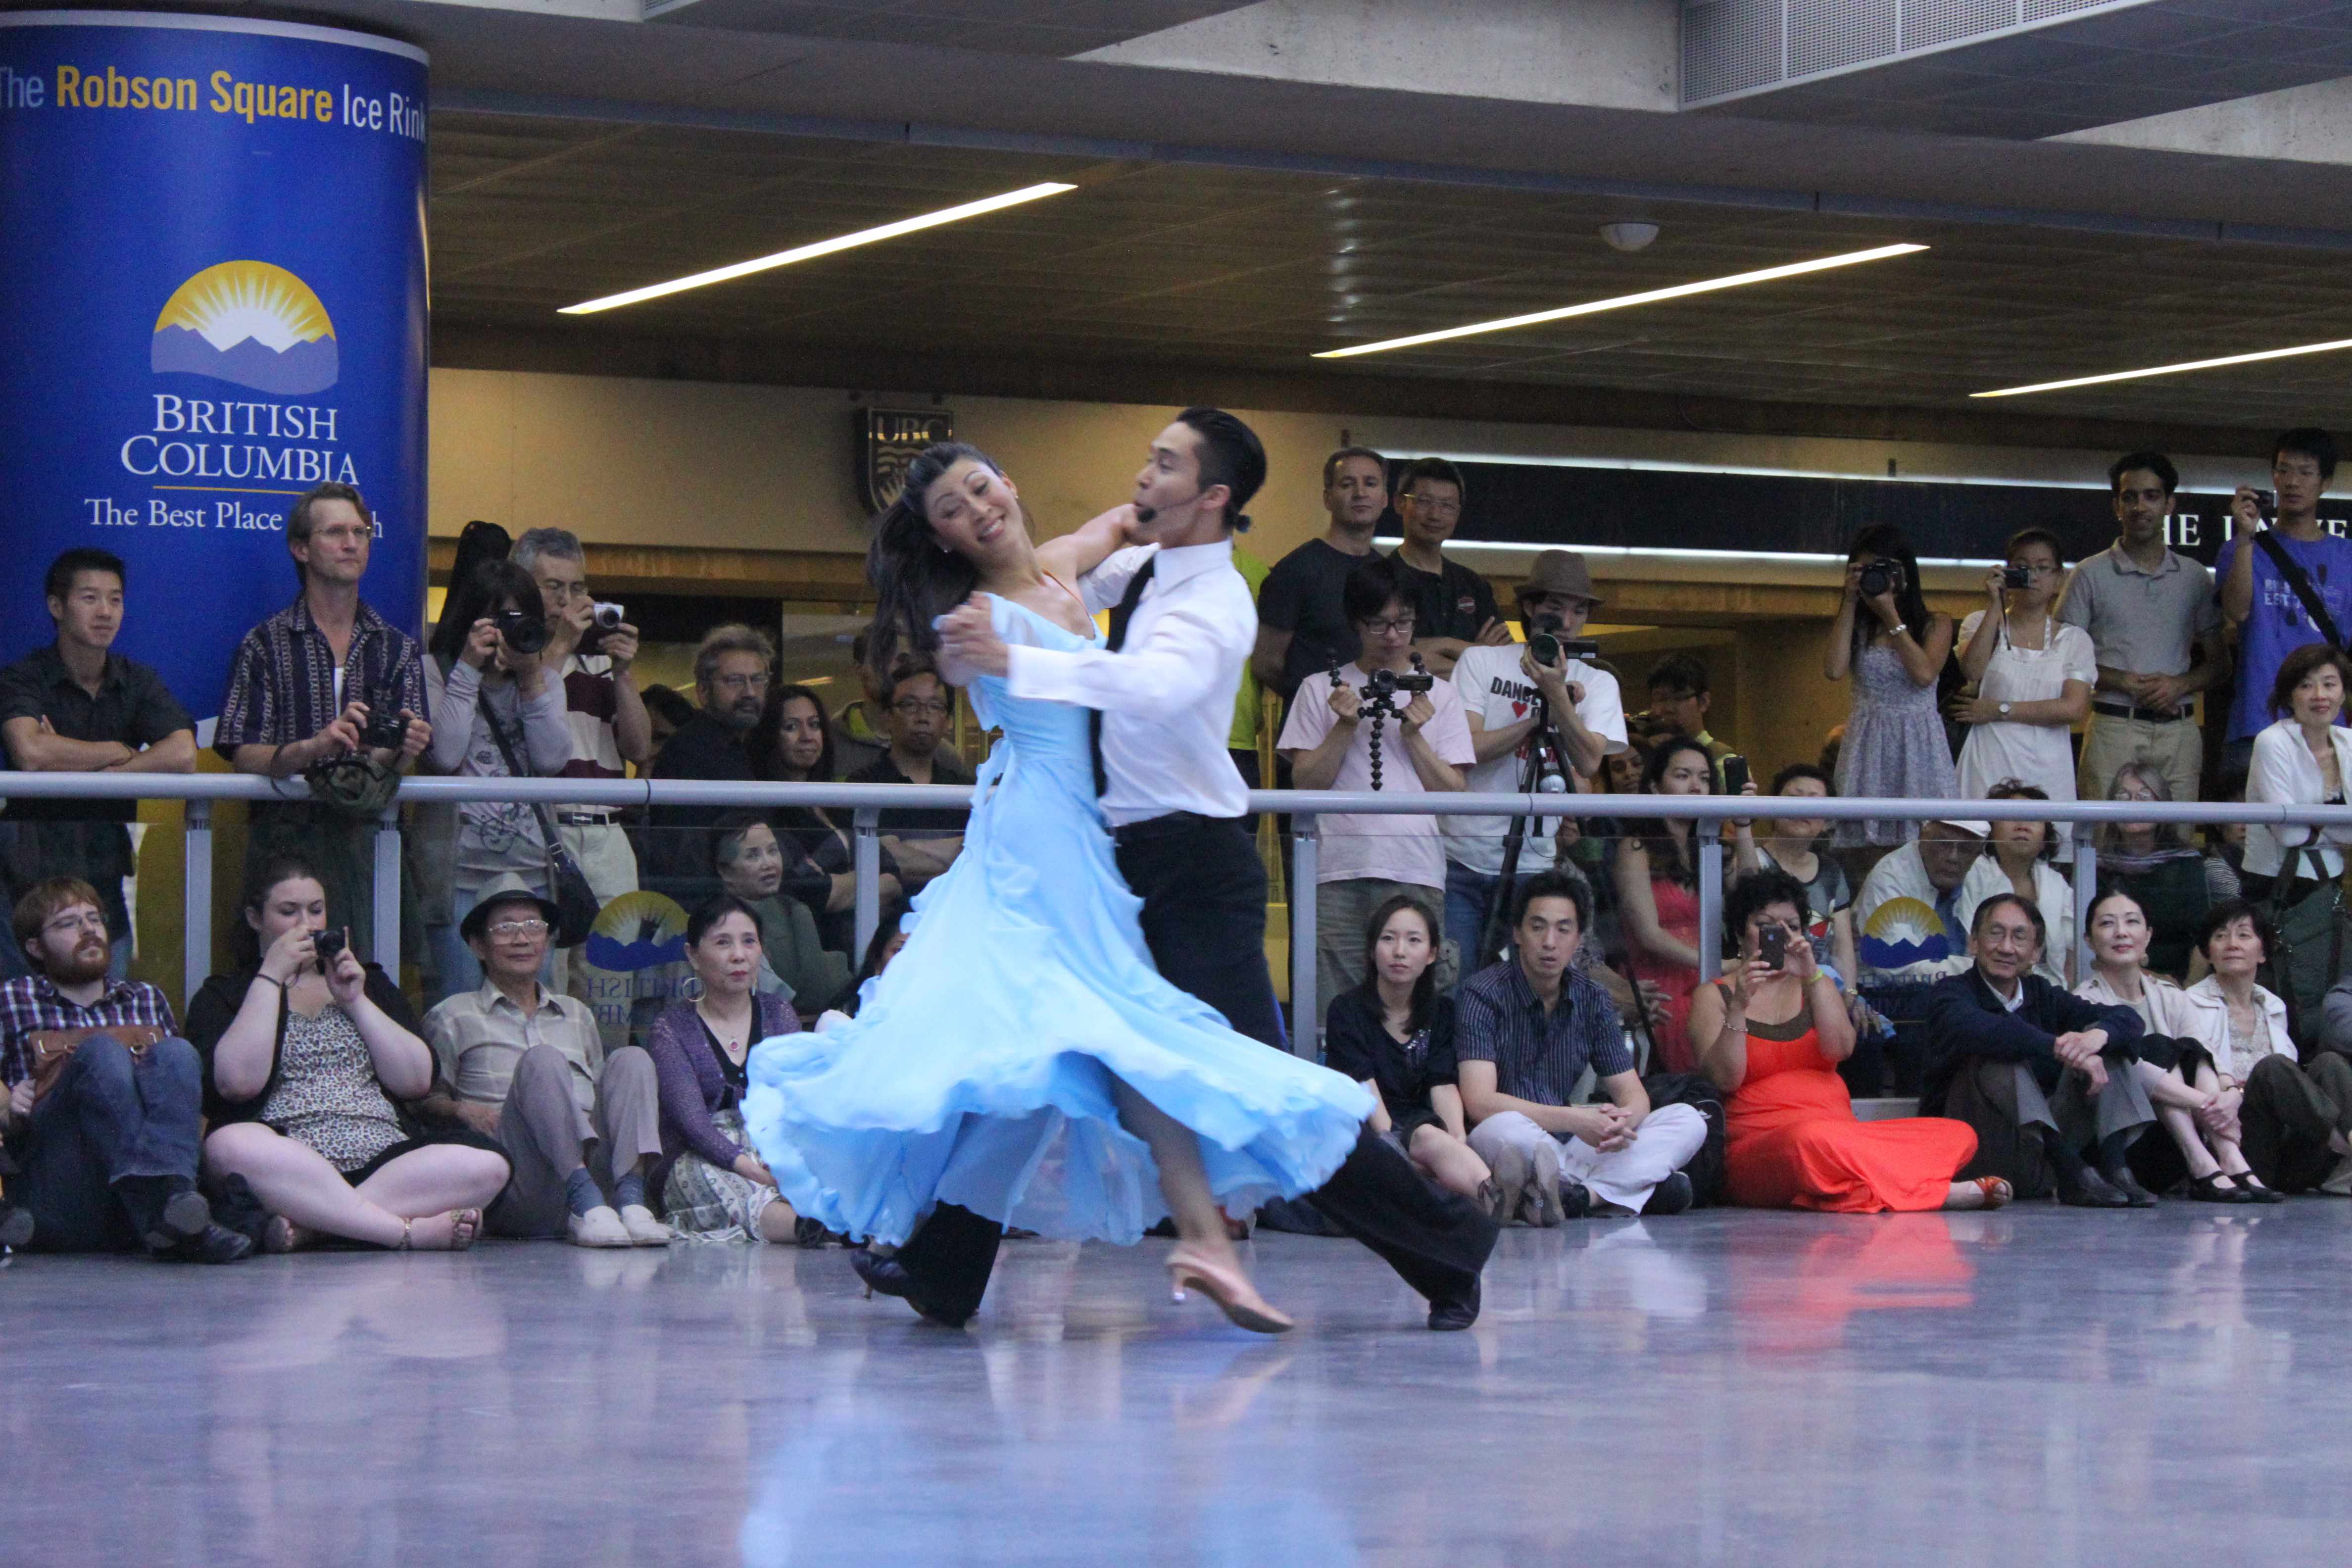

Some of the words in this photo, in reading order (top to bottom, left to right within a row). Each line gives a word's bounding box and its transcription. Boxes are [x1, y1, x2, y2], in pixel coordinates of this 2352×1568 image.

[56, 65, 197, 111] Robson
[210, 70, 333, 124] Square
[343, 84, 383, 131] Ice
[153, 394, 338, 441] BRITISH
[121, 435, 360, 486] COLUMBIA
[84, 498, 139, 526] The
[148, 499, 206, 528] Best
[215, 501, 283, 531] Place
